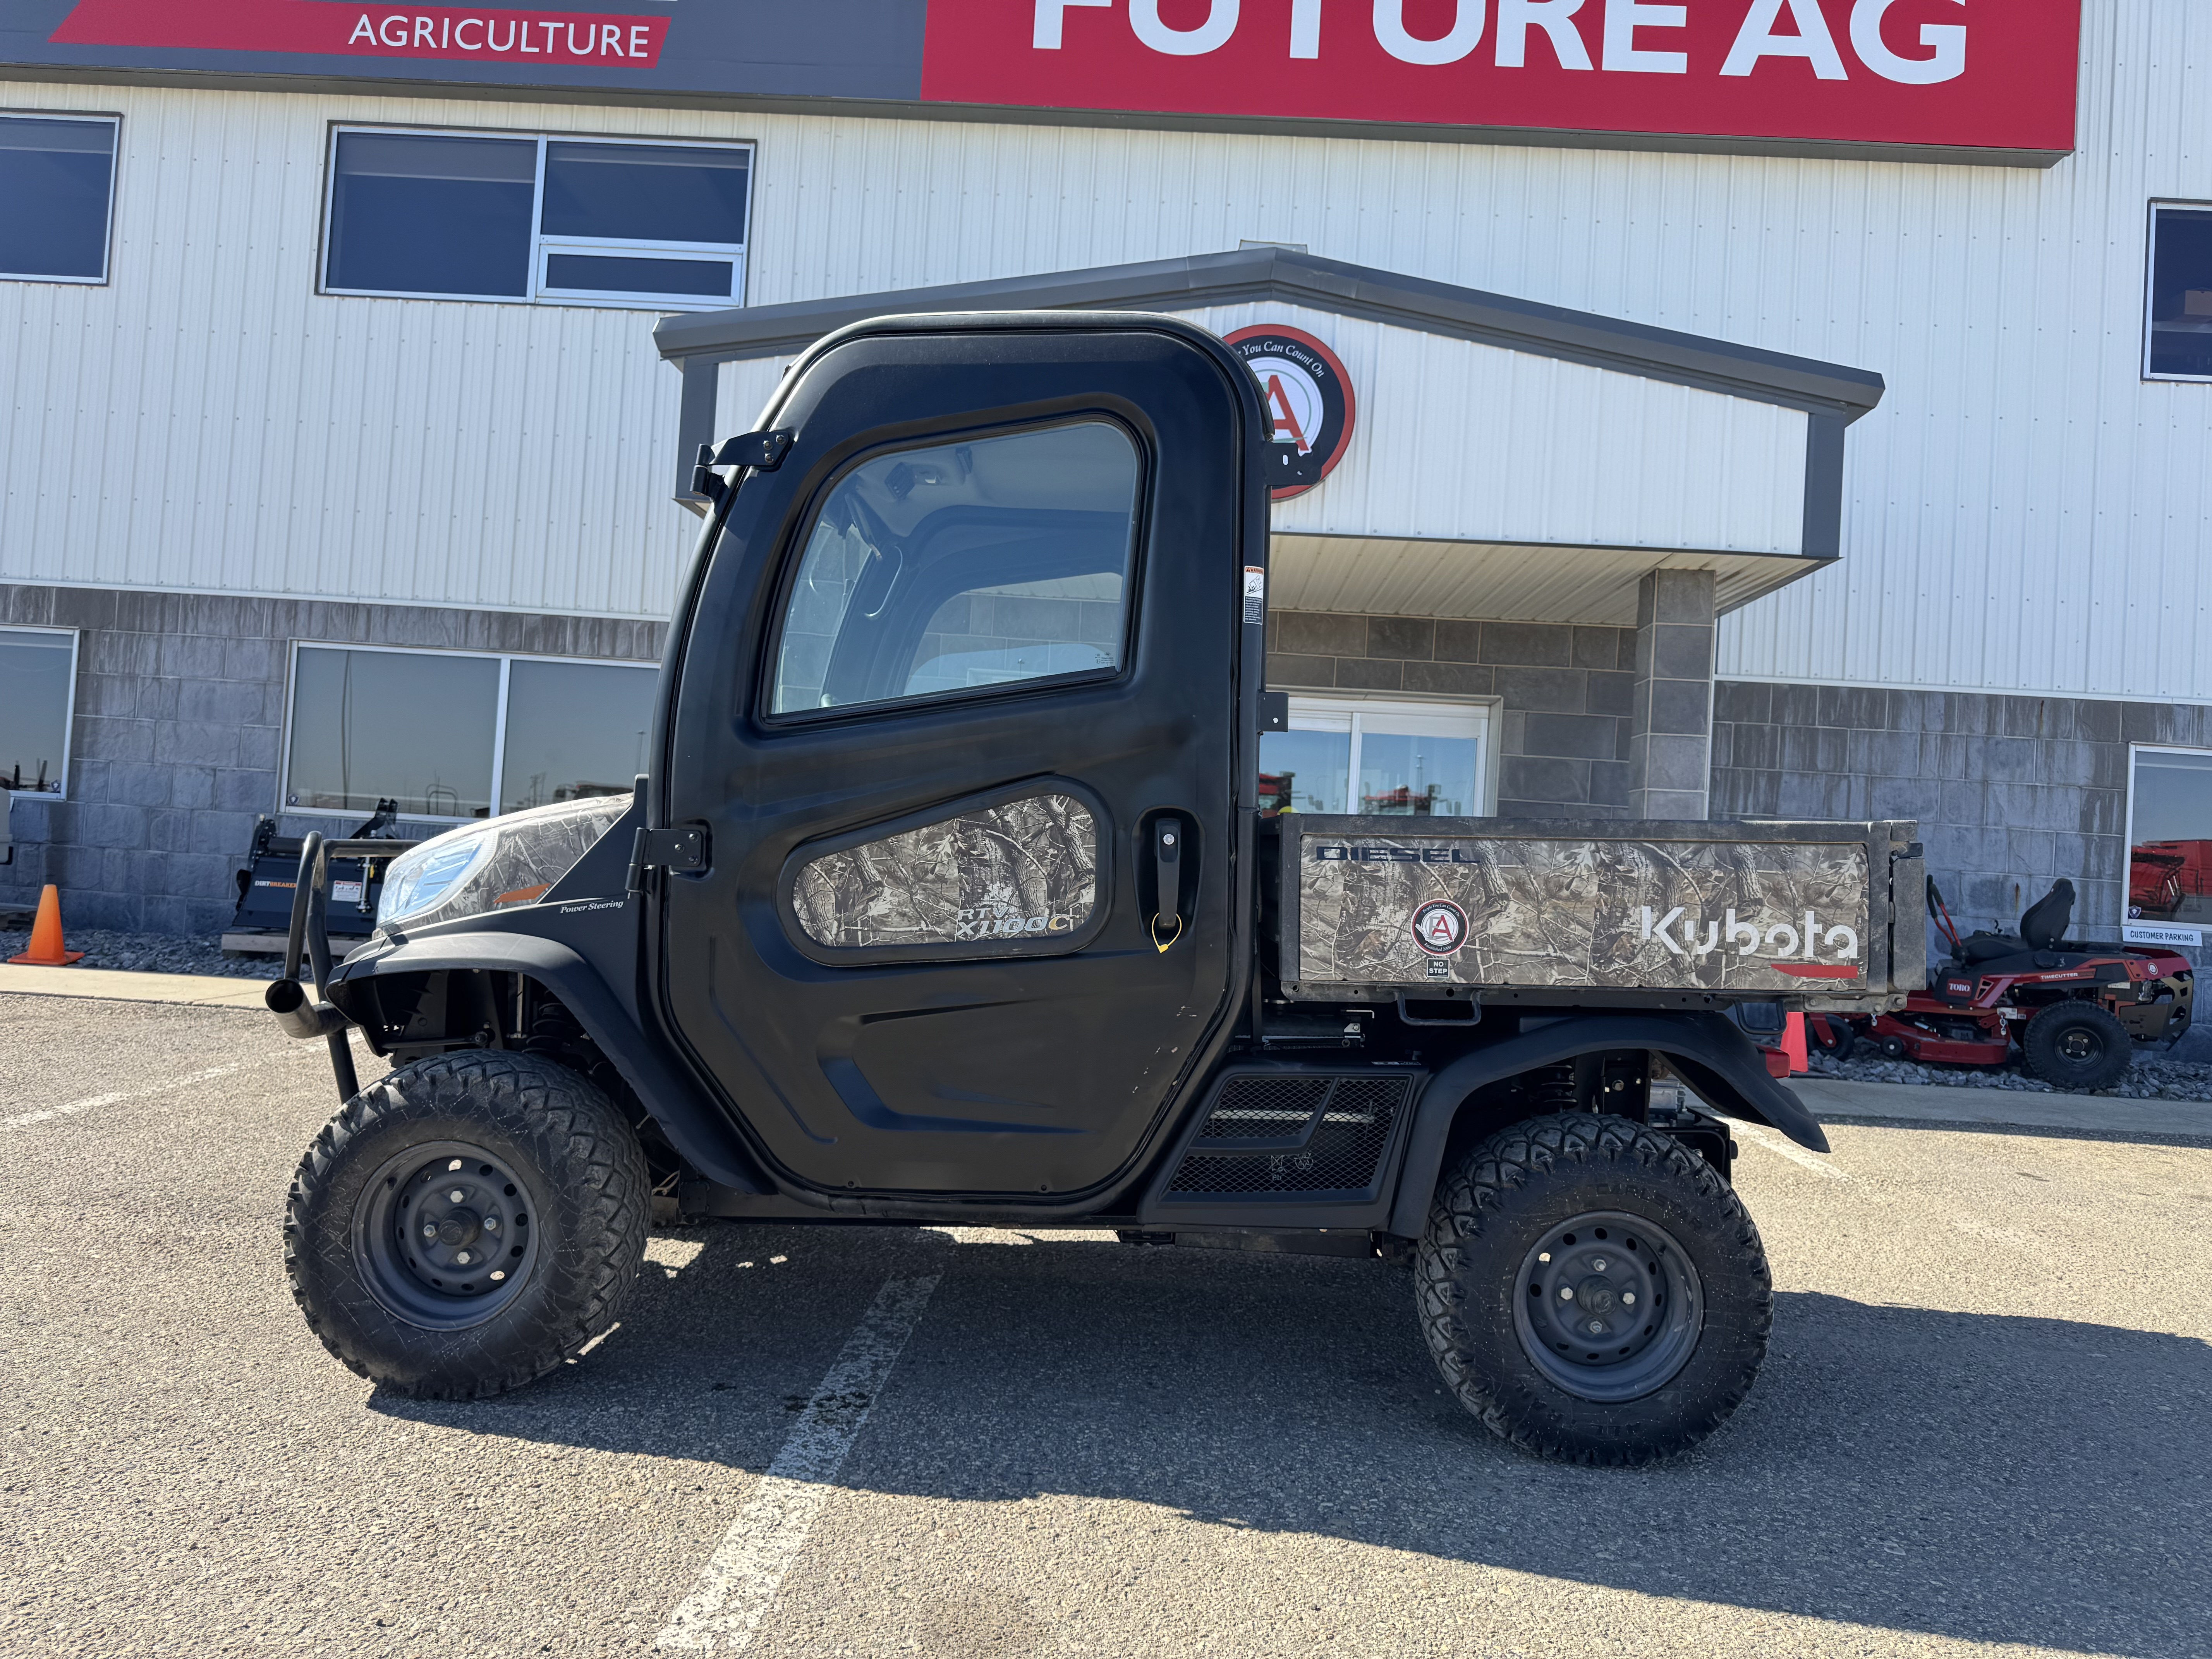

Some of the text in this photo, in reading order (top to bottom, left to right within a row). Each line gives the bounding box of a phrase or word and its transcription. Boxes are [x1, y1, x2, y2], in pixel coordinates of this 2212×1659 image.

[348, 14, 649, 57] AGRICULTURE
[1719, 0, 1967, 85] AG
[1242, 340, 1325, 377] You Can Count On
[1316, 846, 1481, 863] DIESEL
[588, 900, 624, 910] Steering
[959, 907, 1009, 920] RTV
[954, 915, 1069, 936] X1100C
[1642, 906, 1858, 958] Kubota
[2130, 930, 2193, 942] CUSTOMER PARKING
[1949, 983, 1970, 992] TORO
